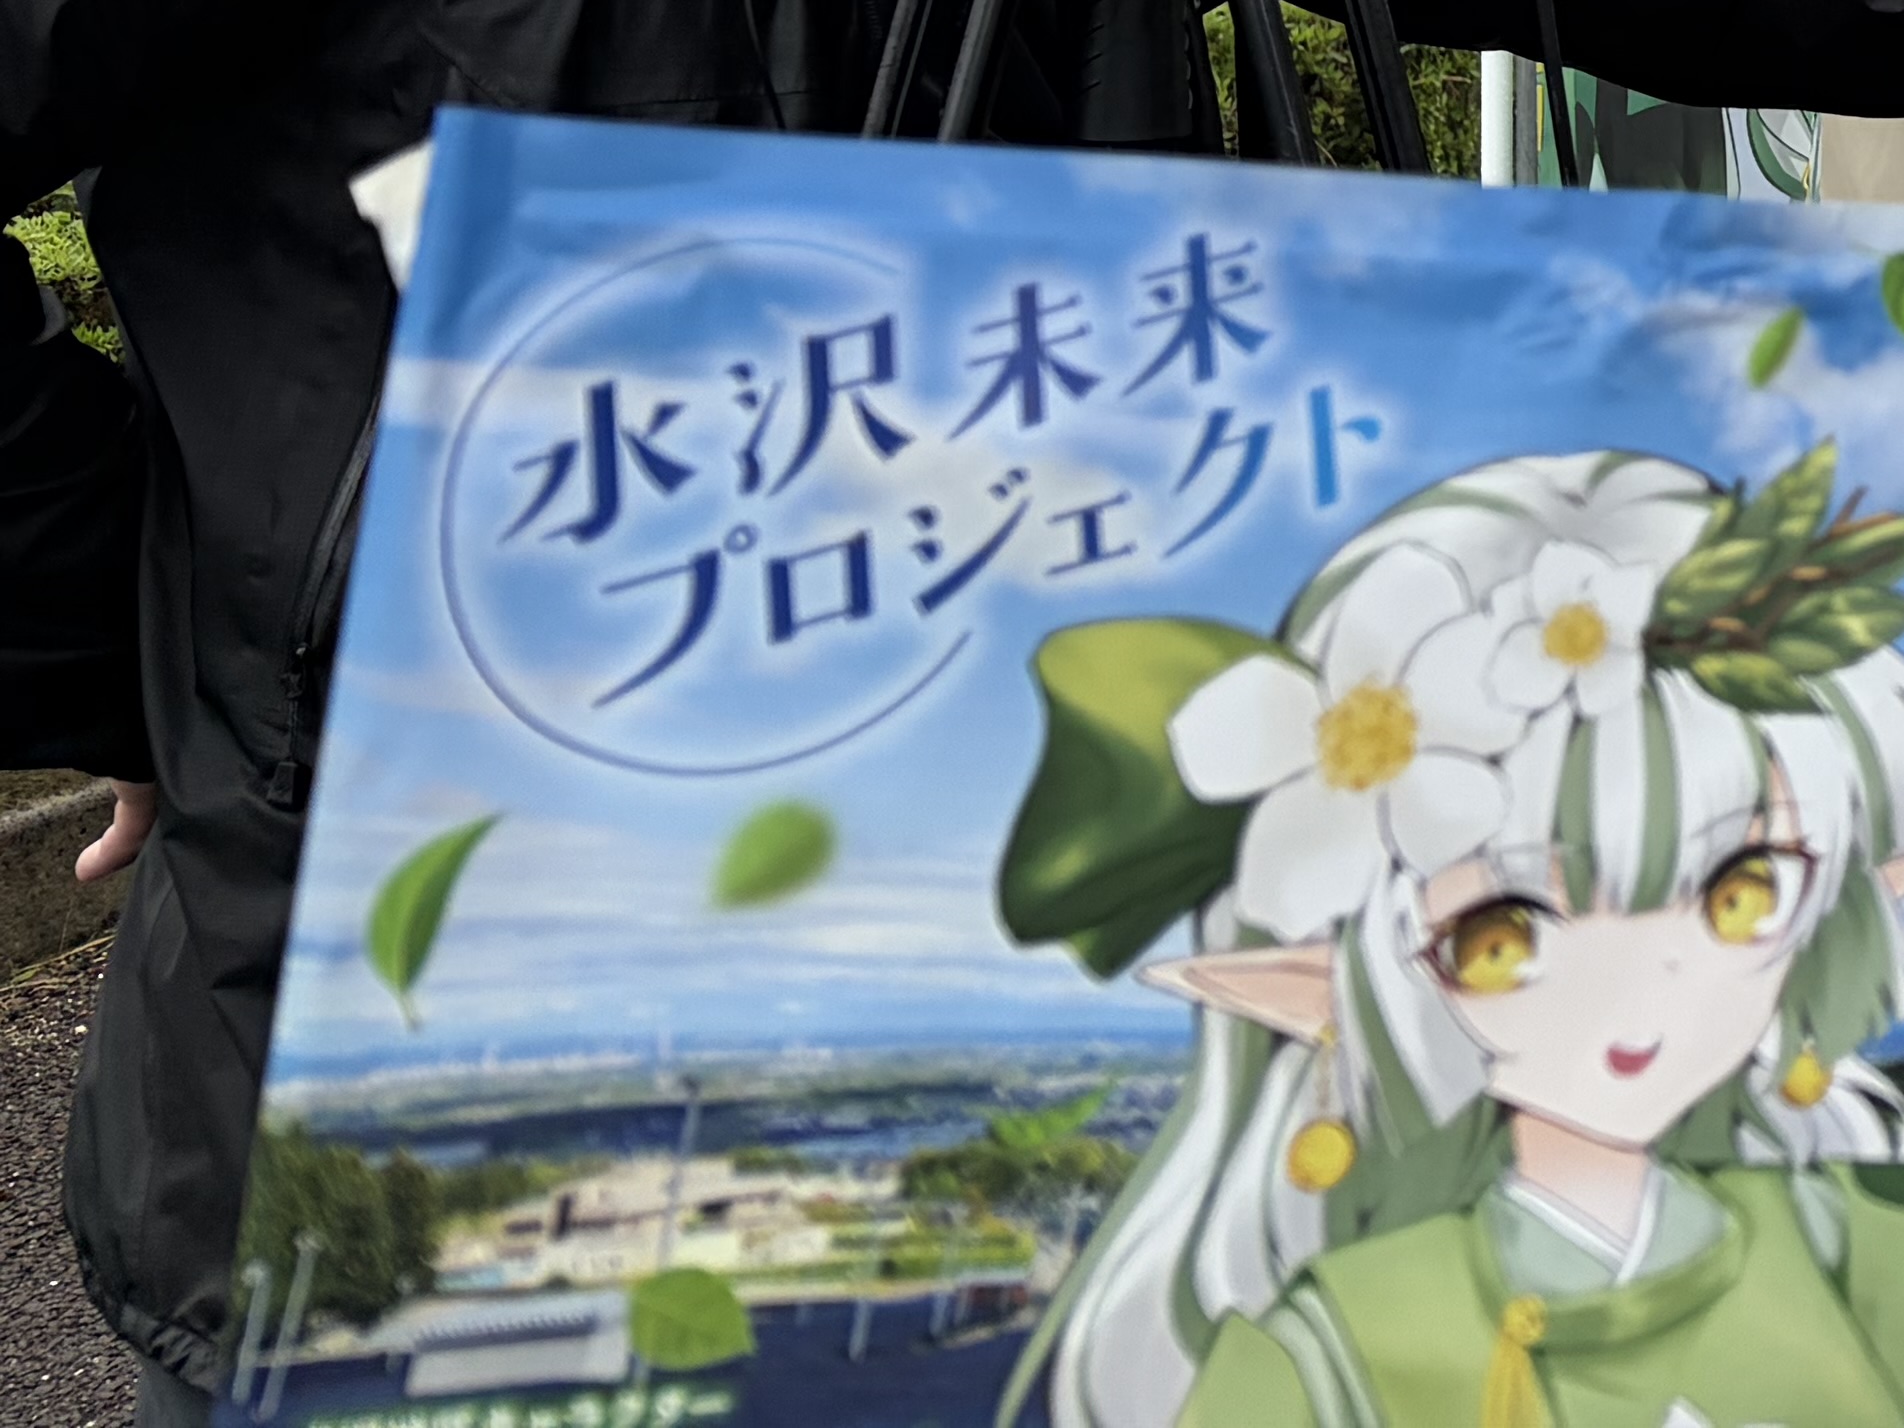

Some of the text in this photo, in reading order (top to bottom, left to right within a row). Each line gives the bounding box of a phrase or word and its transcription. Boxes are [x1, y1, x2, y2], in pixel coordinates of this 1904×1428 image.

[500, 233, 1272, 544] 水沢未来
[591, 385, 1382, 709] プロジェクト
